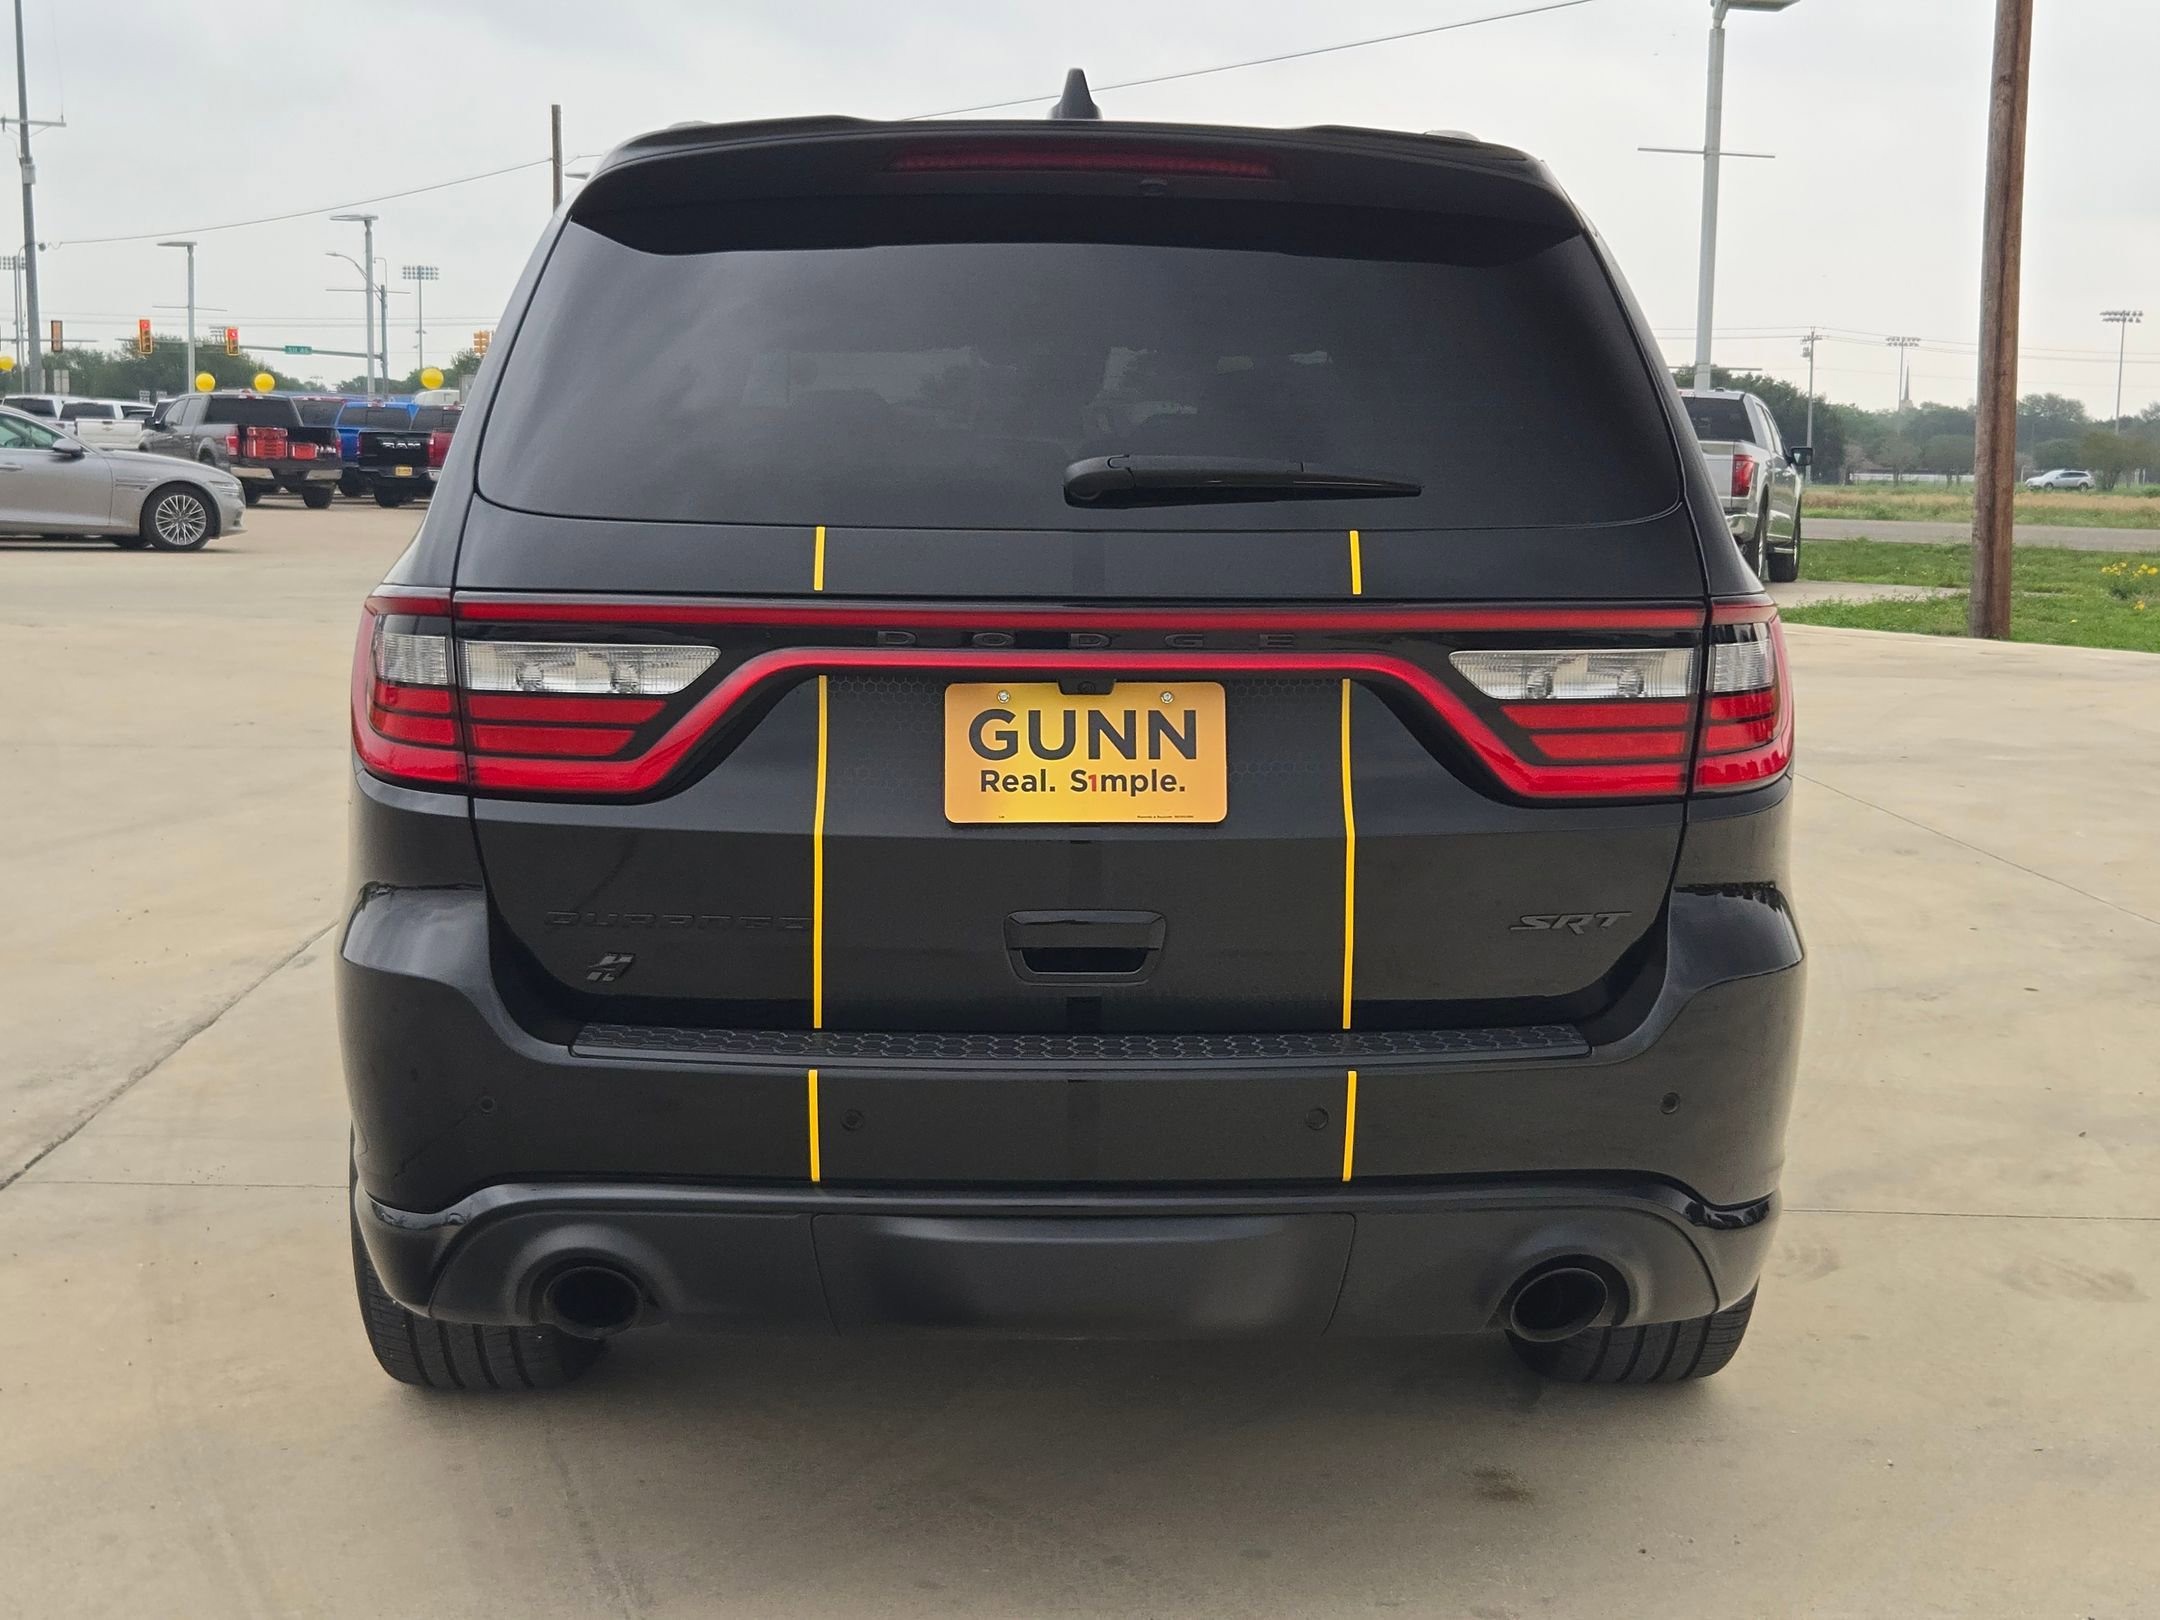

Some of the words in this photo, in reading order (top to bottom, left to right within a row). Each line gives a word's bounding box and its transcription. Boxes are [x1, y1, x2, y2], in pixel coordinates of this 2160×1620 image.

[382, 441, 421, 449] RAM
[877, 631, 1295, 648] DODGE
[968, 708, 1197, 761] GUNN
[980, 769, 1056, 793] Real.
[1070, 769, 1186, 797] S1mple.
[1509, 911, 1633, 935] SRT
